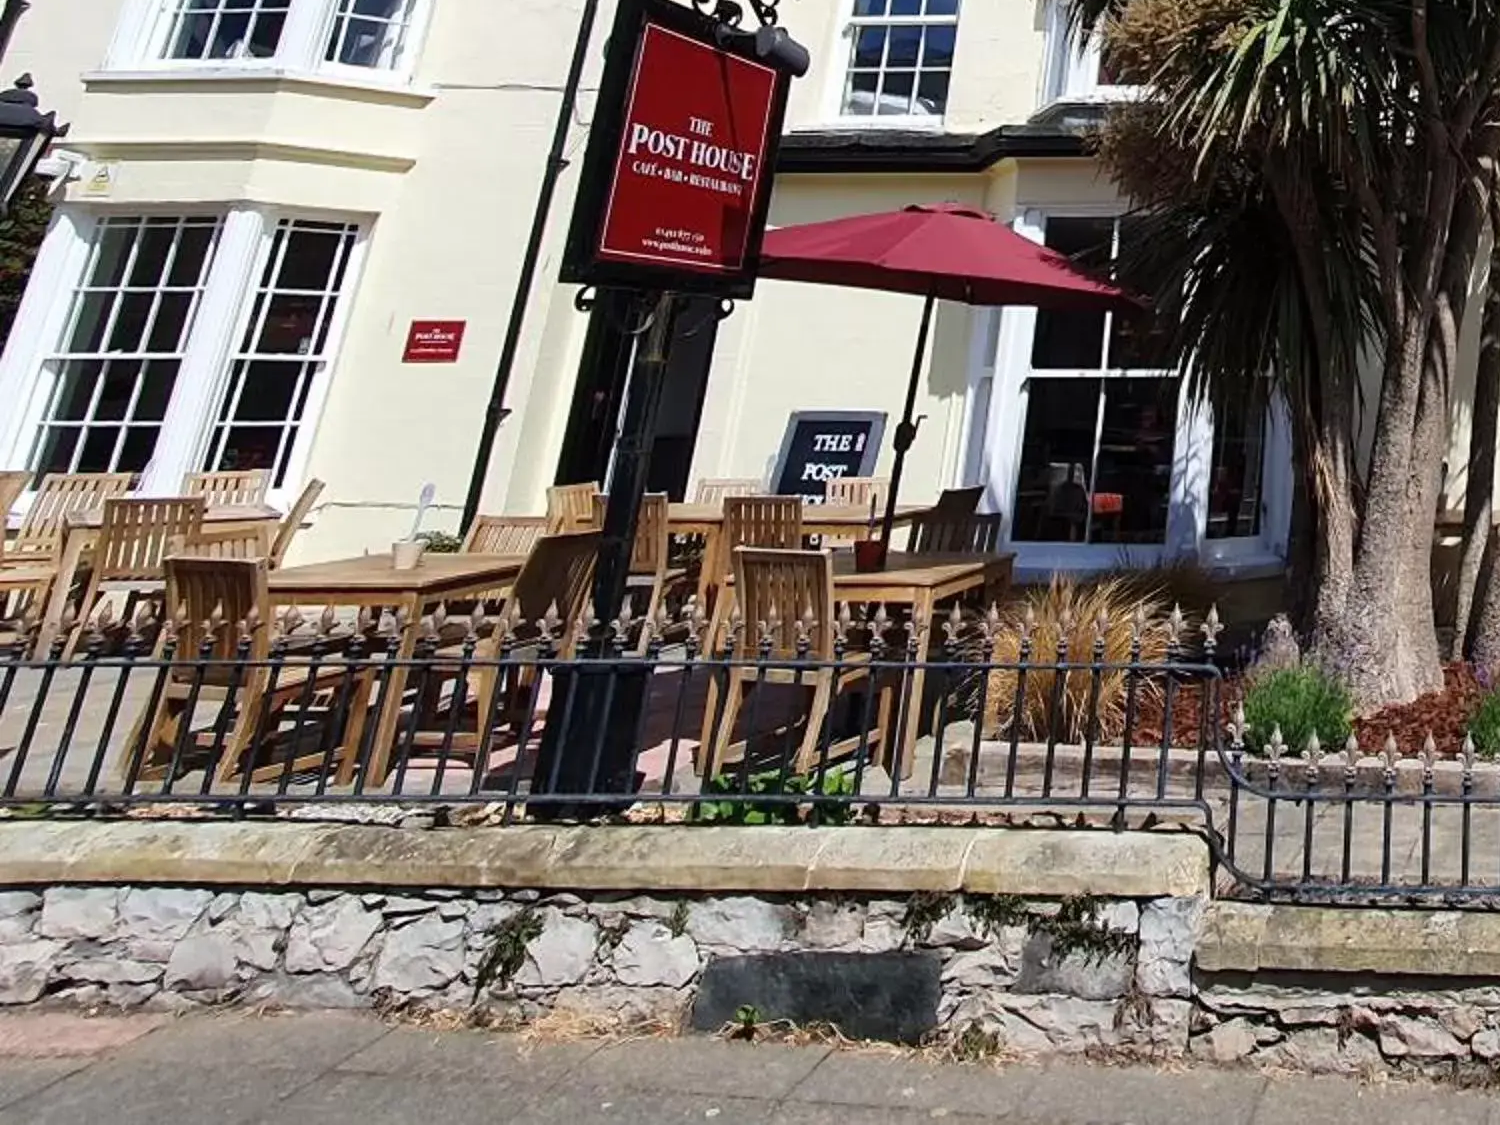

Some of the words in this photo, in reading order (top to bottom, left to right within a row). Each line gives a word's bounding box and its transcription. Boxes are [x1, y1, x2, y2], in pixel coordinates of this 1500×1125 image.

[689, 116, 714, 136] THE
[628, 122, 689, 160] POST
[689, 141, 756, 180] HOUSE
[663, 167, 683, 182] BAR
[689, 173, 742, 196] RESTAURANT
[813, 434, 853, 452] THE
[801, 462, 848, 482] POST
